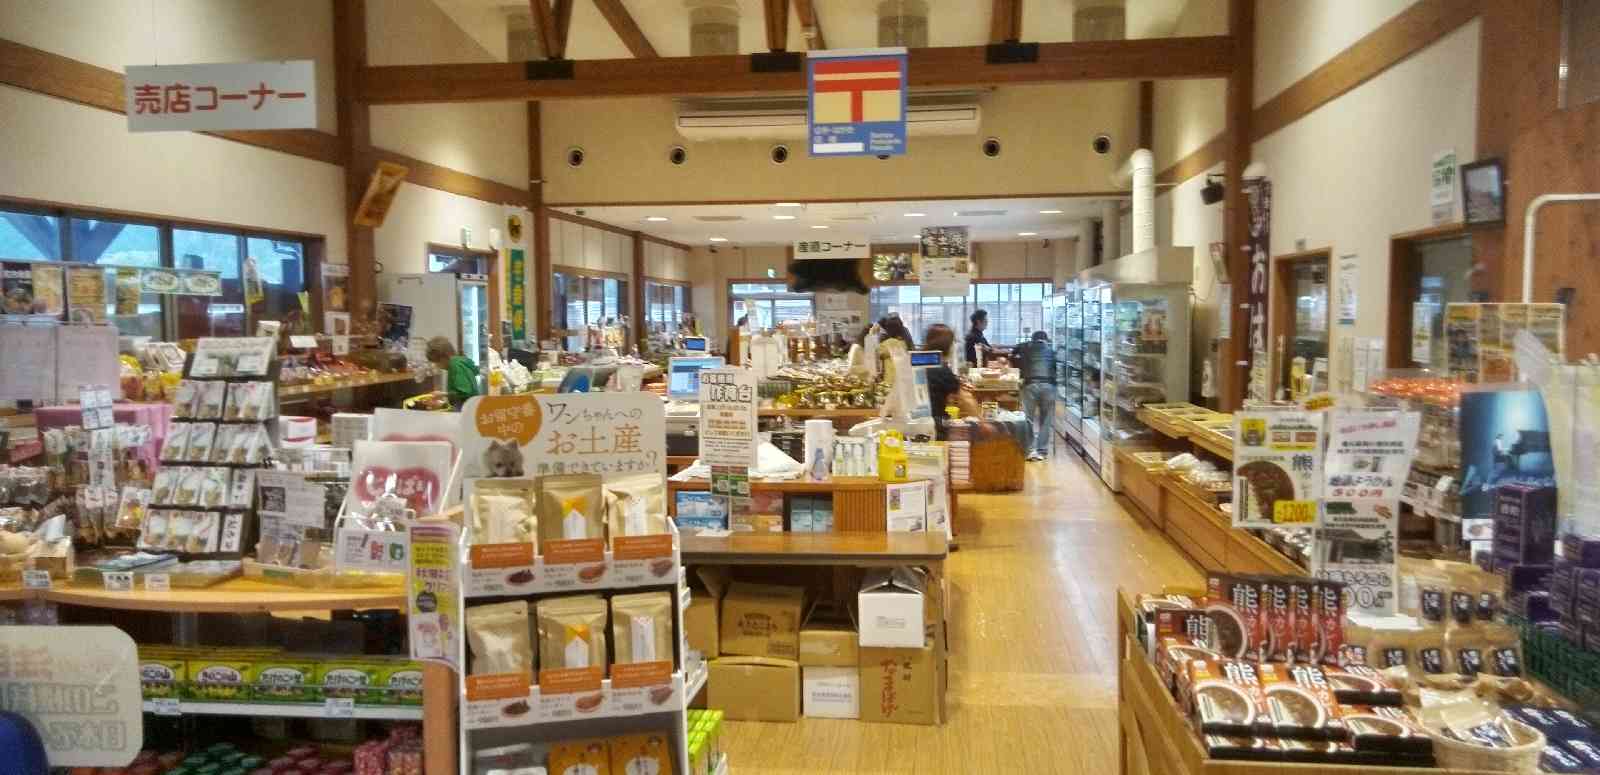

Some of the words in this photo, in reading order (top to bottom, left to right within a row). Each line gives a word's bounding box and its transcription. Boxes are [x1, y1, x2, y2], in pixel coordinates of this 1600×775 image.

[133, 81, 307, 115] 売店コーナー
[547, 402, 642, 425] ワンちゃんへの
[547, 424, 643, 455] お土産
